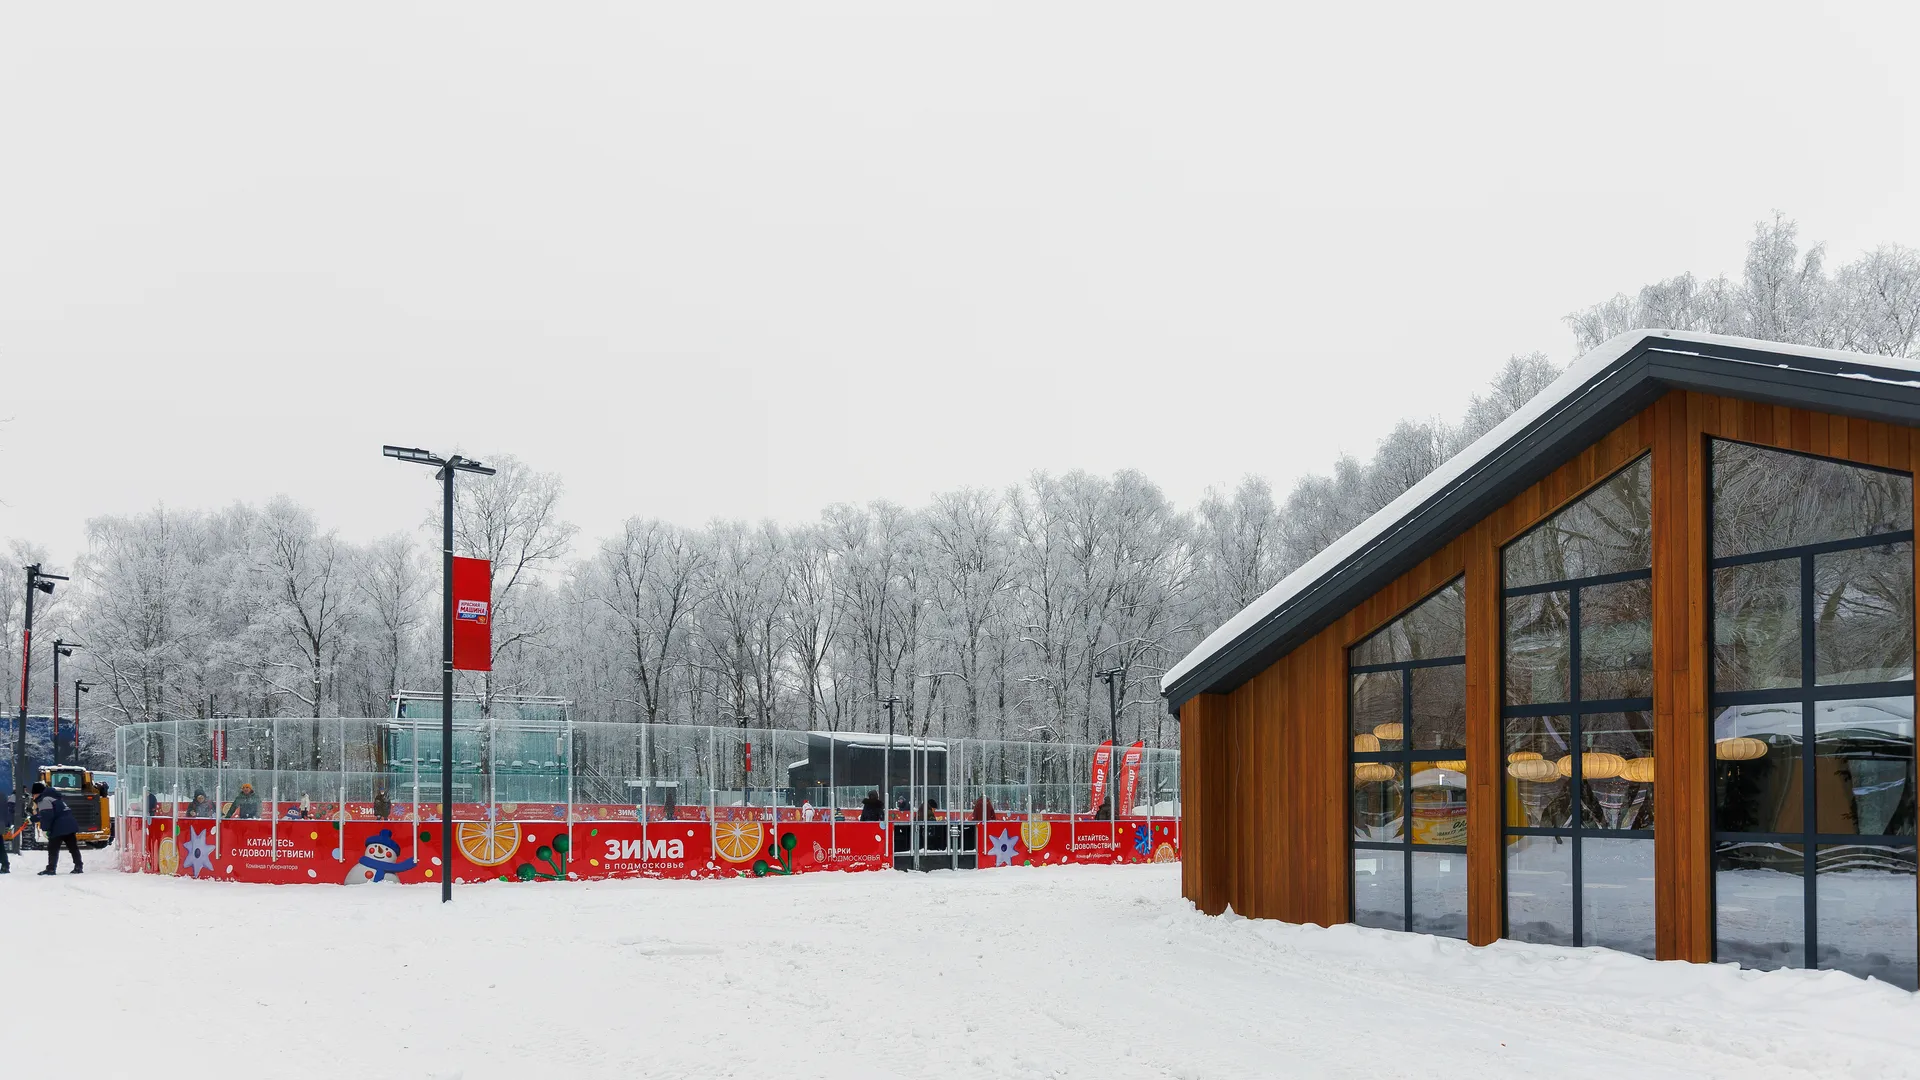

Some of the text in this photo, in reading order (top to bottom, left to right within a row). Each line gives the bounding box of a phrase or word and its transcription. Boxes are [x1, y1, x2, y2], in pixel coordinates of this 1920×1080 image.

[247, 837, 294, 847] КАТАЙЕСЬ
[1077, 834, 1109, 842] КАТАЙТЕСЬ
[1071, 842, 1121, 850] ДОВОЛЬСТВИМ!
[231, 848, 237, 857] С
